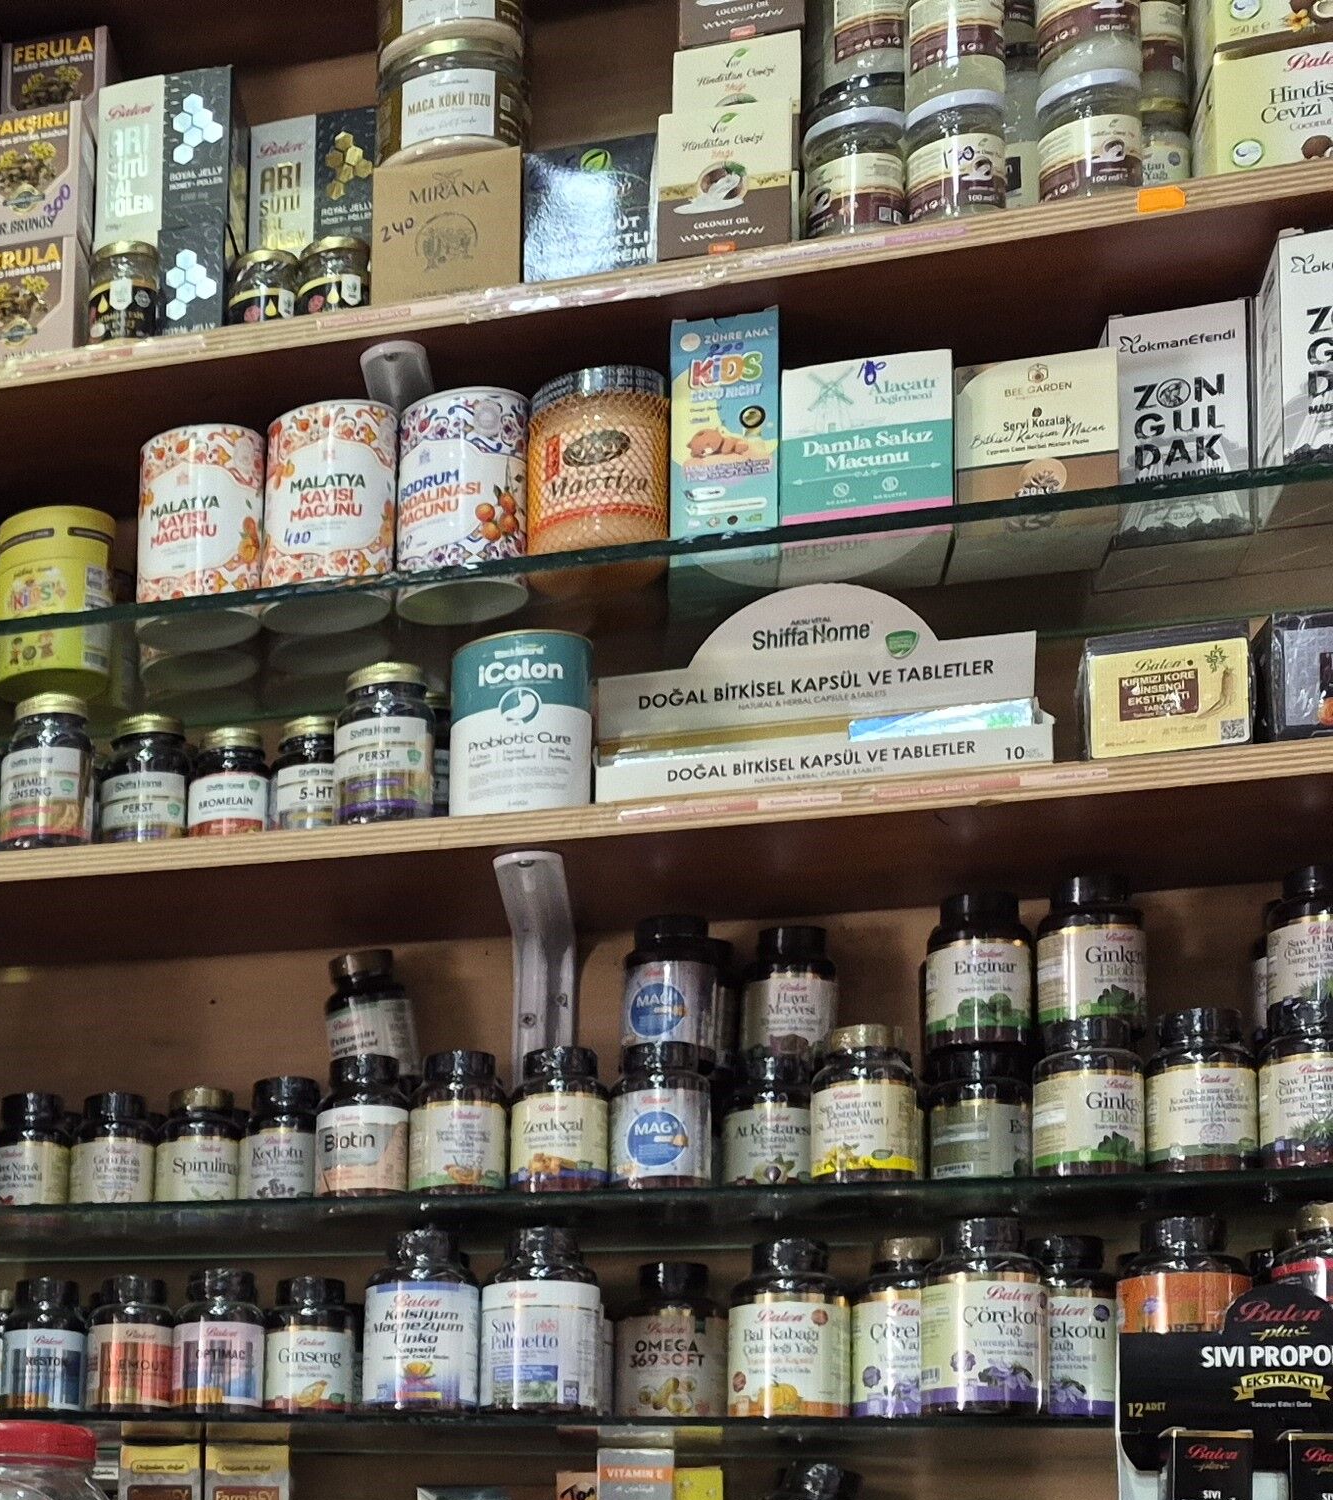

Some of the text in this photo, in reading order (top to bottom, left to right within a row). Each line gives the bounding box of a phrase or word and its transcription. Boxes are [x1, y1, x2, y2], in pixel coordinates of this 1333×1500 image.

[12, 35, 94, 66] FERULA
[1283, 49, 1333, 73] Bale
[1270, 80, 1333, 106] Hindis
[407, 97, 435, 118] MACA
[1260, 103, 1323, 125] Cevizi
[259, 161, 302, 194] ARI
[43, 183, 71, 218] 300
[408, 178, 491, 207] MIRANA
[380, 215, 415, 244] 240
[693, 216, 751, 230] COCONUT OIL
[703, 327, 770, 346] ZÜHRE ANA
[1004, 380, 1073, 399] BEE GARDEN
[1032, 413, 1074, 428] Kozalak
[1133, 404, 1227, 440] GUL
[802, 427, 935, 459] Damla Sakız
[1133, 433, 1224, 471] DAK
[824, 450, 911, 474] Macunu
[289, 472, 367, 493] MALATYA
[149, 494, 221, 518] MALATYA
[299, 488, 355, 508] KAYISI
[157, 511, 208, 532] KAYISI
[289, 502, 363, 523] MACUNU
[149, 524, 218, 549] MACUNU
[751, 621, 871, 652] Shiffa Home
[637, 658, 995, 711] DOĞAL BİTKİSEL KAPSÜL VE TABLETLER
[1121, 675, 1162, 688] KIRMIZI
[1163, 670, 1196, 681] KORE
[467, 733, 535, 757] Probiotic
[536, 731, 573, 746] Cure
[666, 739, 1026, 783] DOĞAL BİTKİSEL KAPSÜL VE TABLETLER 10
[298, 785, 333, 801] 5-HT
[953, 960, 1018, 979] Enginar
[323, 1130, 376, 1154] Biotin
[986, 1286, 1035, 1303] Balen
[385, 1308, 460, 1323] Kalsiyum
[756, 1309, 806, 1325] Balen
[1233, 1301, 1324, 1324] Balen
[490, 1333, 560, 1351] Palmetto
[634, 1338, 700, 1356] OMEGA
[277, 1347, 342, 1369] Ginseng
[660, 1352, 706, 1369] SOFT
[1200, 1345, 1333, 1370] SIVI PROPO
[1245, 1373, 1321, 1391] EKSTRAKTI
[1127, 1401, 1167, 1418] 12 ADET
[1186, 1443, 1239, 1462] Balen
[605, 1467, 664, 1480] VITAMIN E
[1202, 1489, 1222, 1500] SIVI
